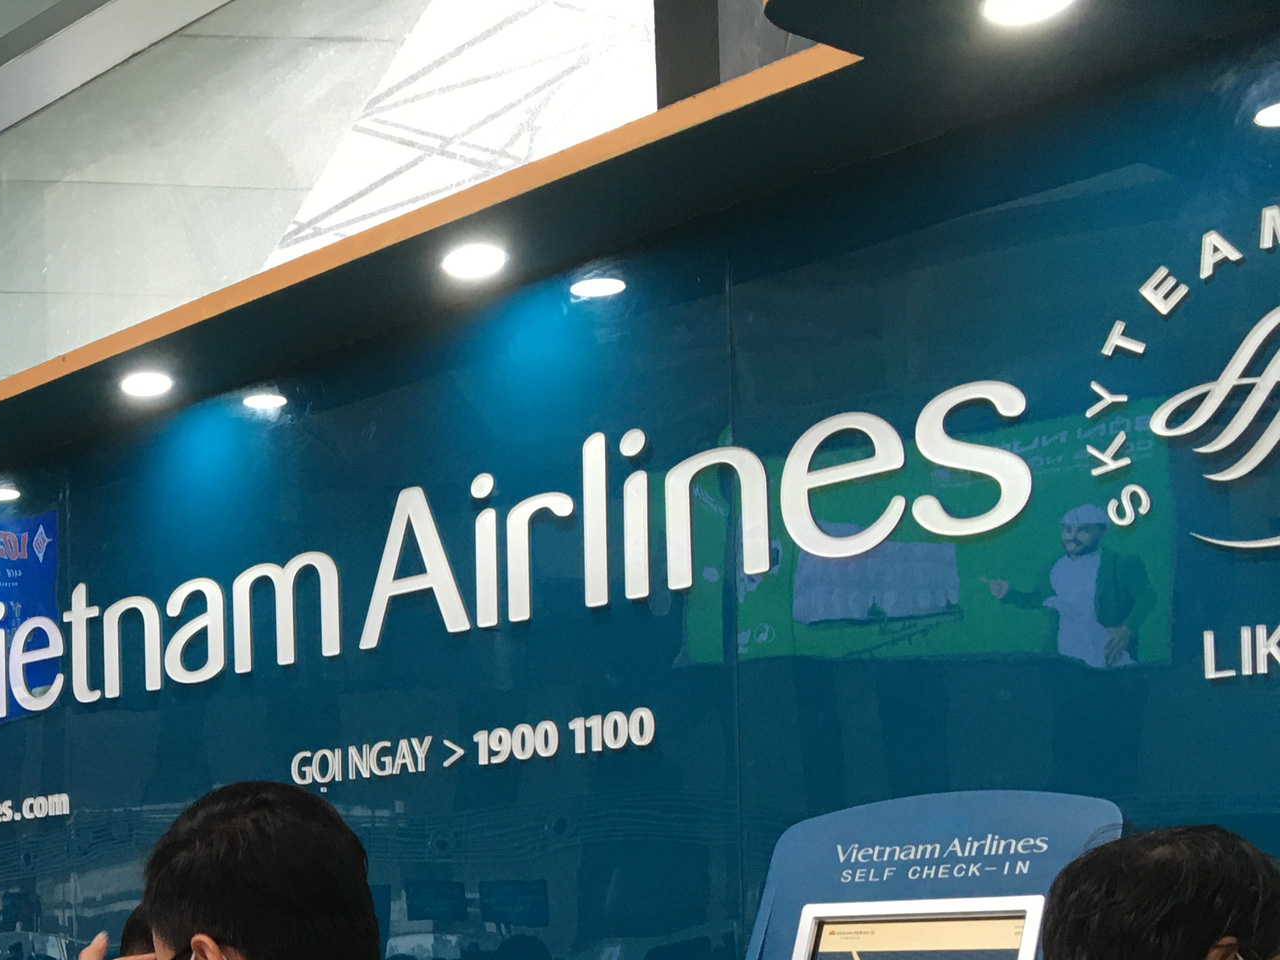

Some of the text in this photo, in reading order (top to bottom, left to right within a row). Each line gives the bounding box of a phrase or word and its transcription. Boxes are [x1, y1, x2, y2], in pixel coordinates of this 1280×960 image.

[359, 380, 1034, 650] Airlines
[291, 748, 342, 793] GỌI
[348, 735, 433, 780] NGAY
[473, 720, 559, 766] 1900
[568, 707, 655, 754] 1100
[835, 833, 1049, 863] Vietnam Airlines
[840, 860, 1030, 883] SELF CHECK-IN
